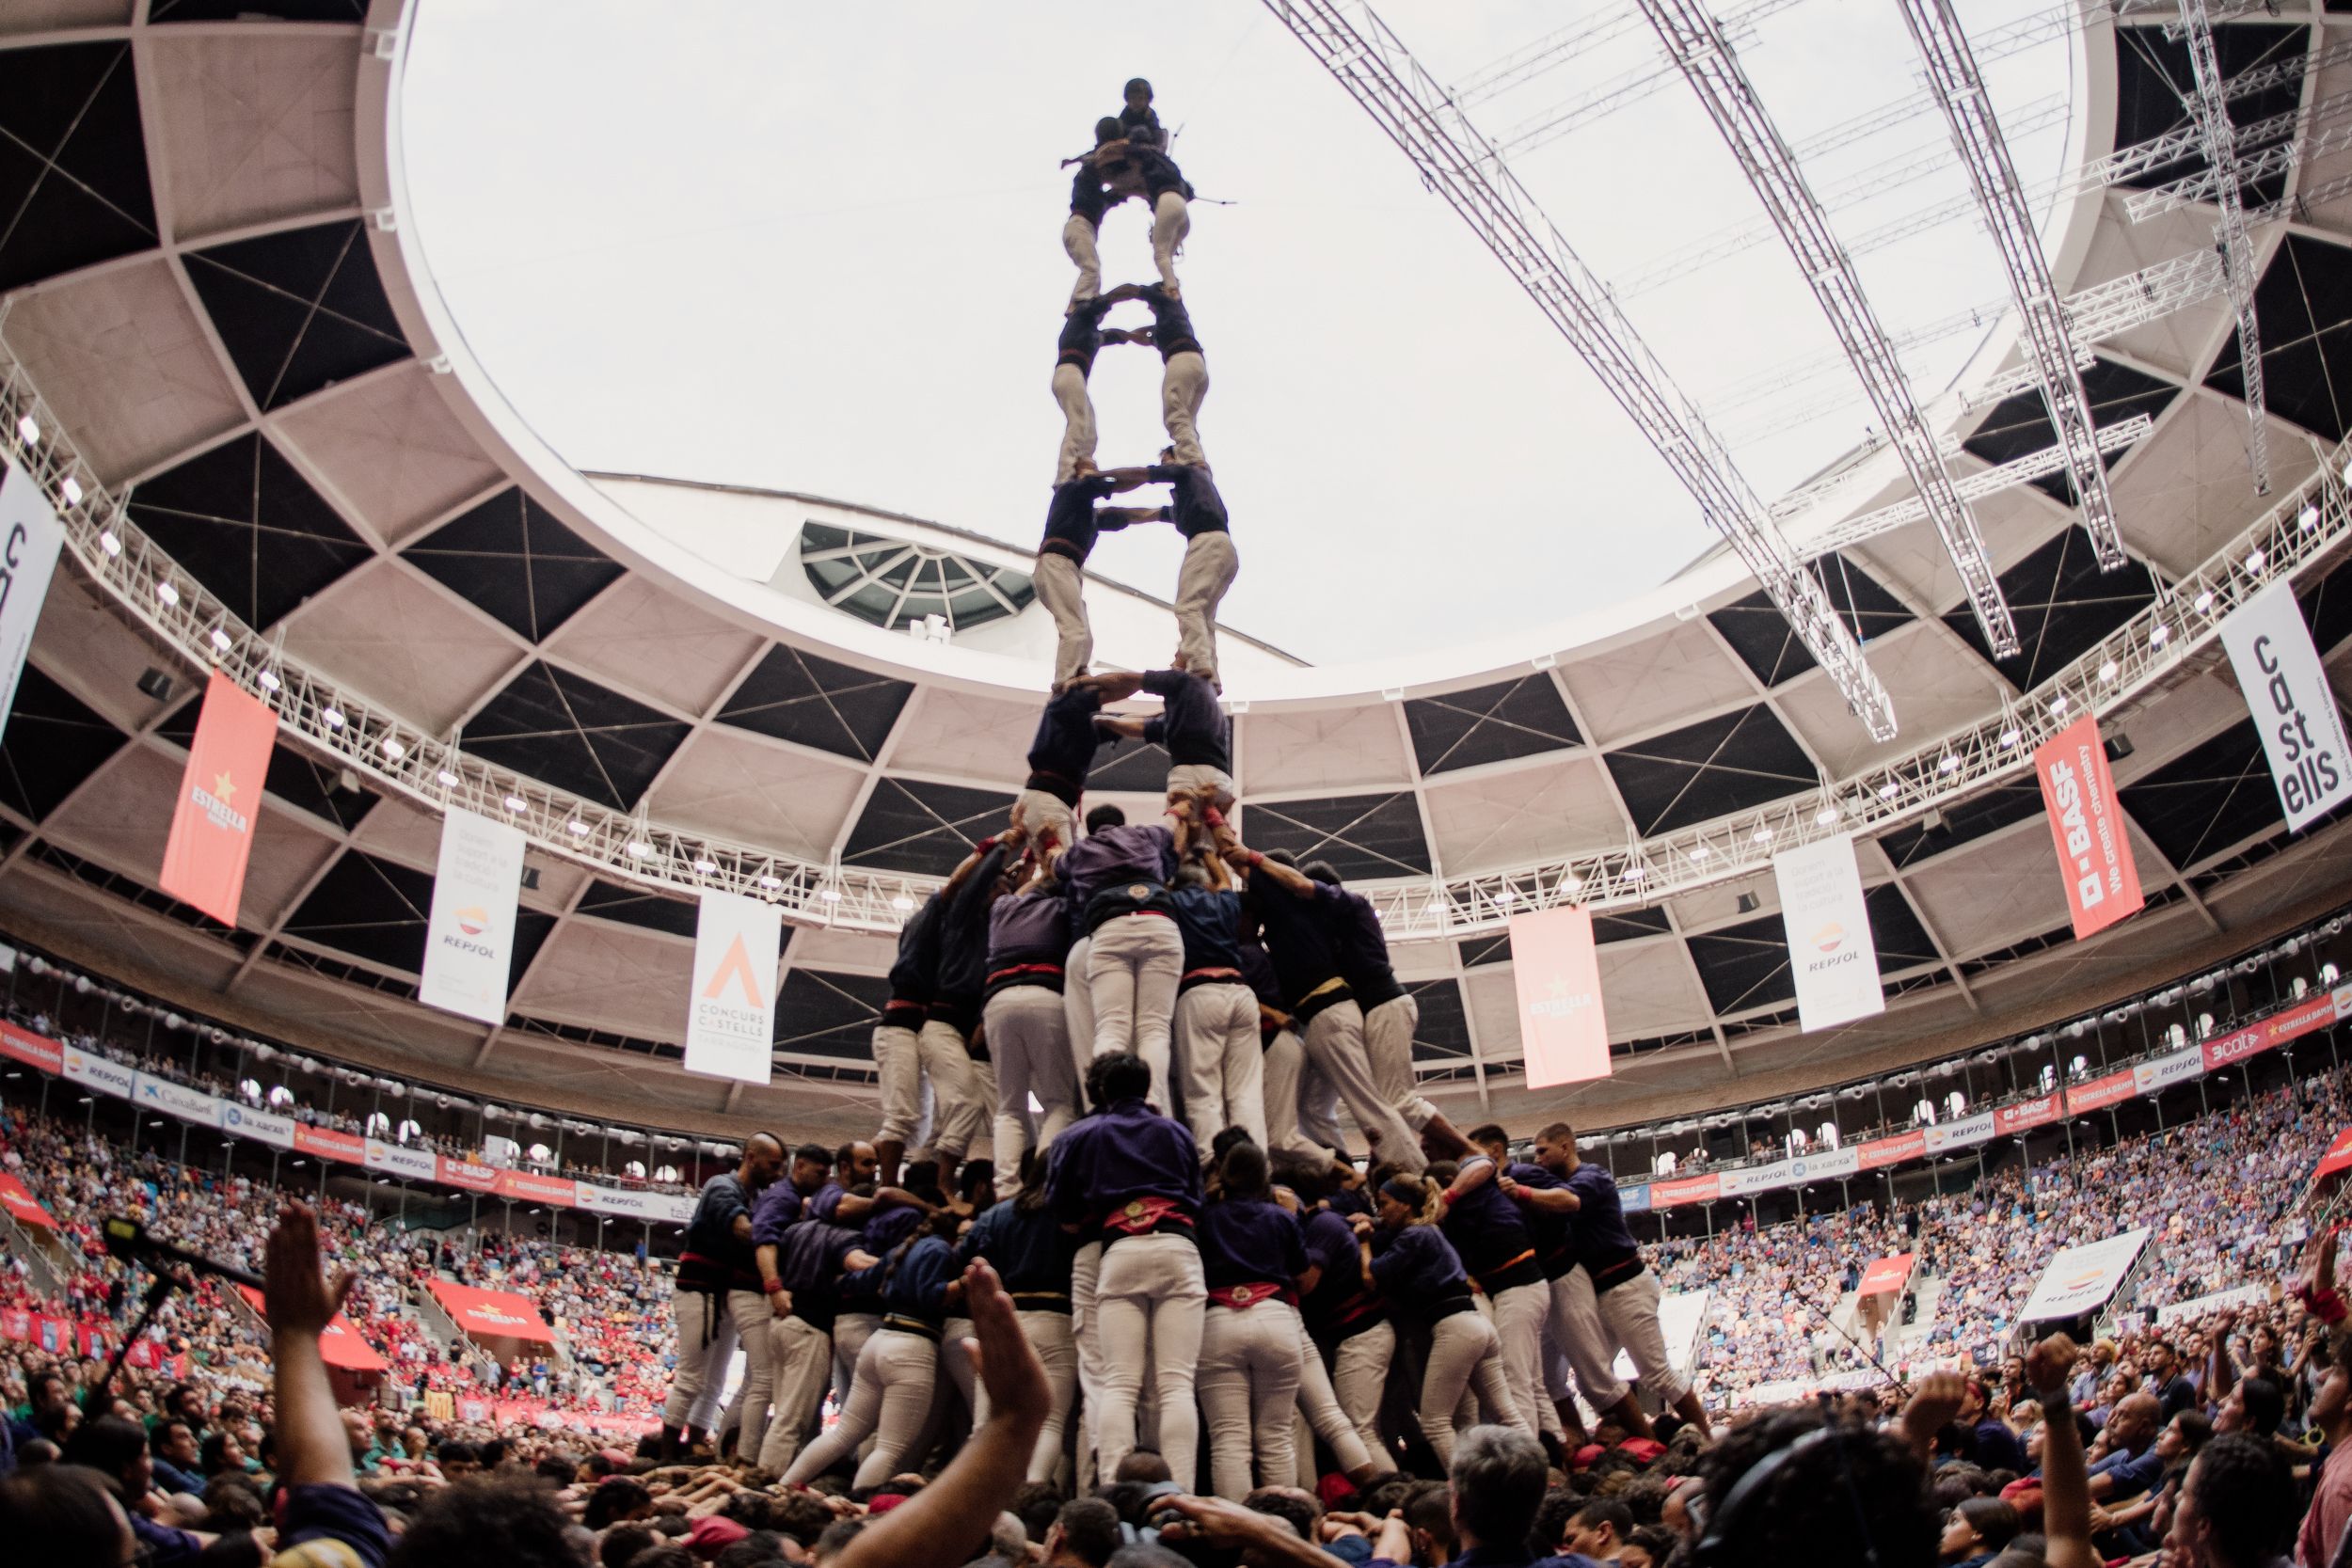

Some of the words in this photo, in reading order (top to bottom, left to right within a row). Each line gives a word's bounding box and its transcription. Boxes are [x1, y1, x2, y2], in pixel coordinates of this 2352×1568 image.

[2078, 745, 2102, 815] chemistry
[192, 784, 247, 833] ESTRELLA
[2049, 760, 2091, 858] BASF
[2096, 817, 2115, 863] create
[2108, 866, 2122, 895] We
[1809, 893, 1844, 911] cultura
[442, 934, 496, 959] REPSOL
[1809, 950, 1860, 973] REPSOL
[699, 1003, 765, 1024] CONCURS
[1529, 993, 1593, 1016] ESTRELLA
[698, 1016, 763, 1037] CASTELLS
[2279, 1014, 2312, 1033] ESTRELLA
[2312, 1005, 2333, 1021] DAMM
[2212, 1032, 2249, 1061] 3cat
[88, 1066, 131, 1087] REPSOL
[2161, 1056, 2201, 1076] REPSOL
[2077, 1089, 2112, 1103] ESTRELLA
[2113, 1079, 2135, 1094] DAMM
[161, 1089, 213, 1116] CaixaBank
[2019, 1099, 2052, 1116] BASF
[243, 1114, 254, 1126] la
[1952, 1122, 1994, 1139] REPSOL
[1868, 1145, 1902, 1159] ESTRELLA
[1903, 1138, 1925, 1152] DAMM
[390, 1153, 433, 1170] REPSOL
[462, 1164, 496, 1180] BASF
[1808, 1162, 1819, 1172] la
[1746, 1169, 1788, 1184] REPSOL
[1661, 1185, 1695, 1197] ESTRELLA
[1696, 1182, 1719, 1194] DAMM
[601, 1195, 644, 1208] REPSOL
